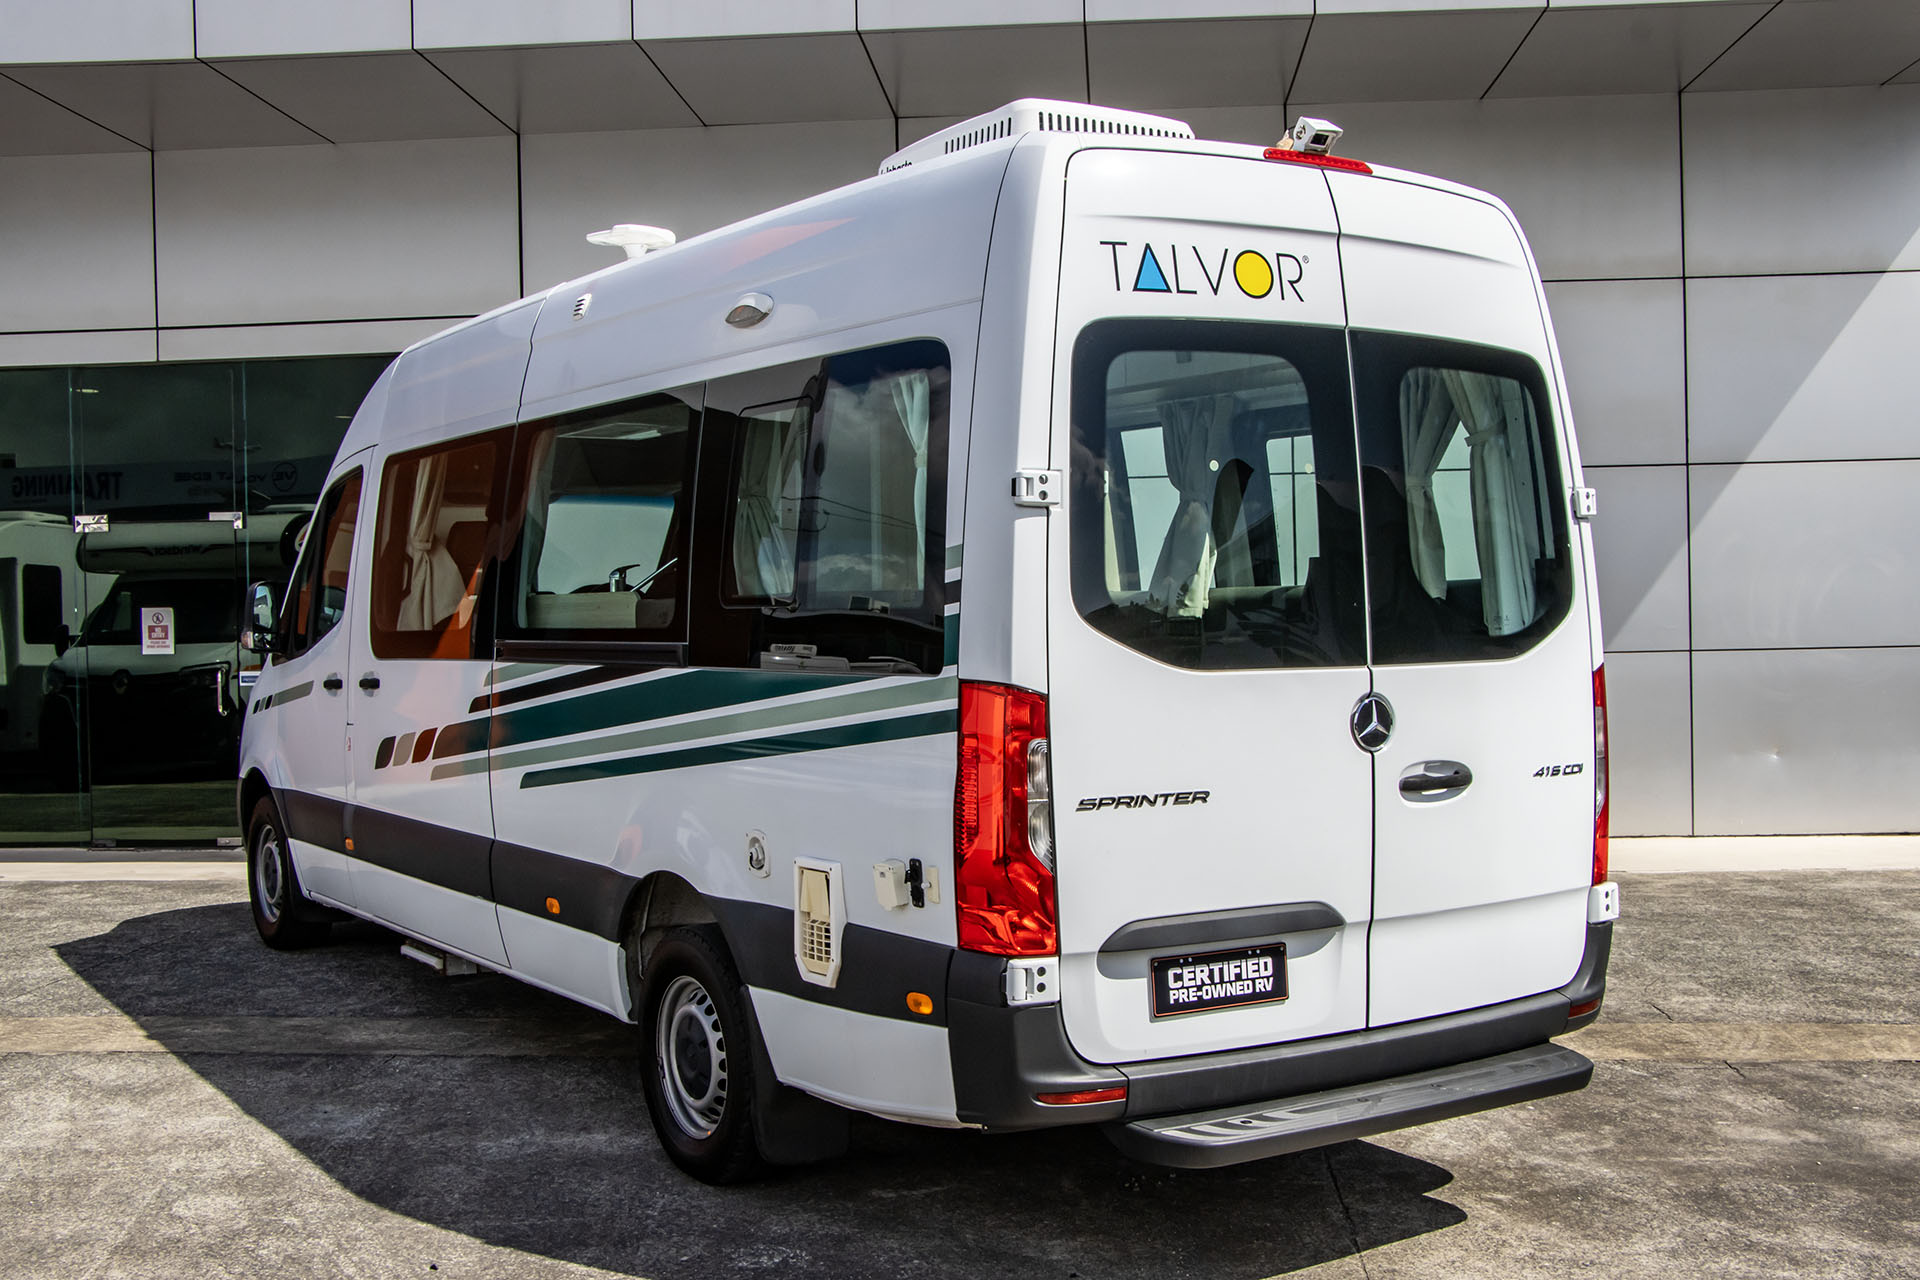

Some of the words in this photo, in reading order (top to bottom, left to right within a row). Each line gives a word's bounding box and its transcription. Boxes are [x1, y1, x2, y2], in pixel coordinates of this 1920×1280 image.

[1562, 763, 1583, 776] CDI
[1075, 790, 1210, 812] SPRINTER
[1167, 955, 1274, 989] CERTIFIED
[1169, 980, 1253, 1005] PRE-OWNED
[1255, 977, 1274, 993] RV
